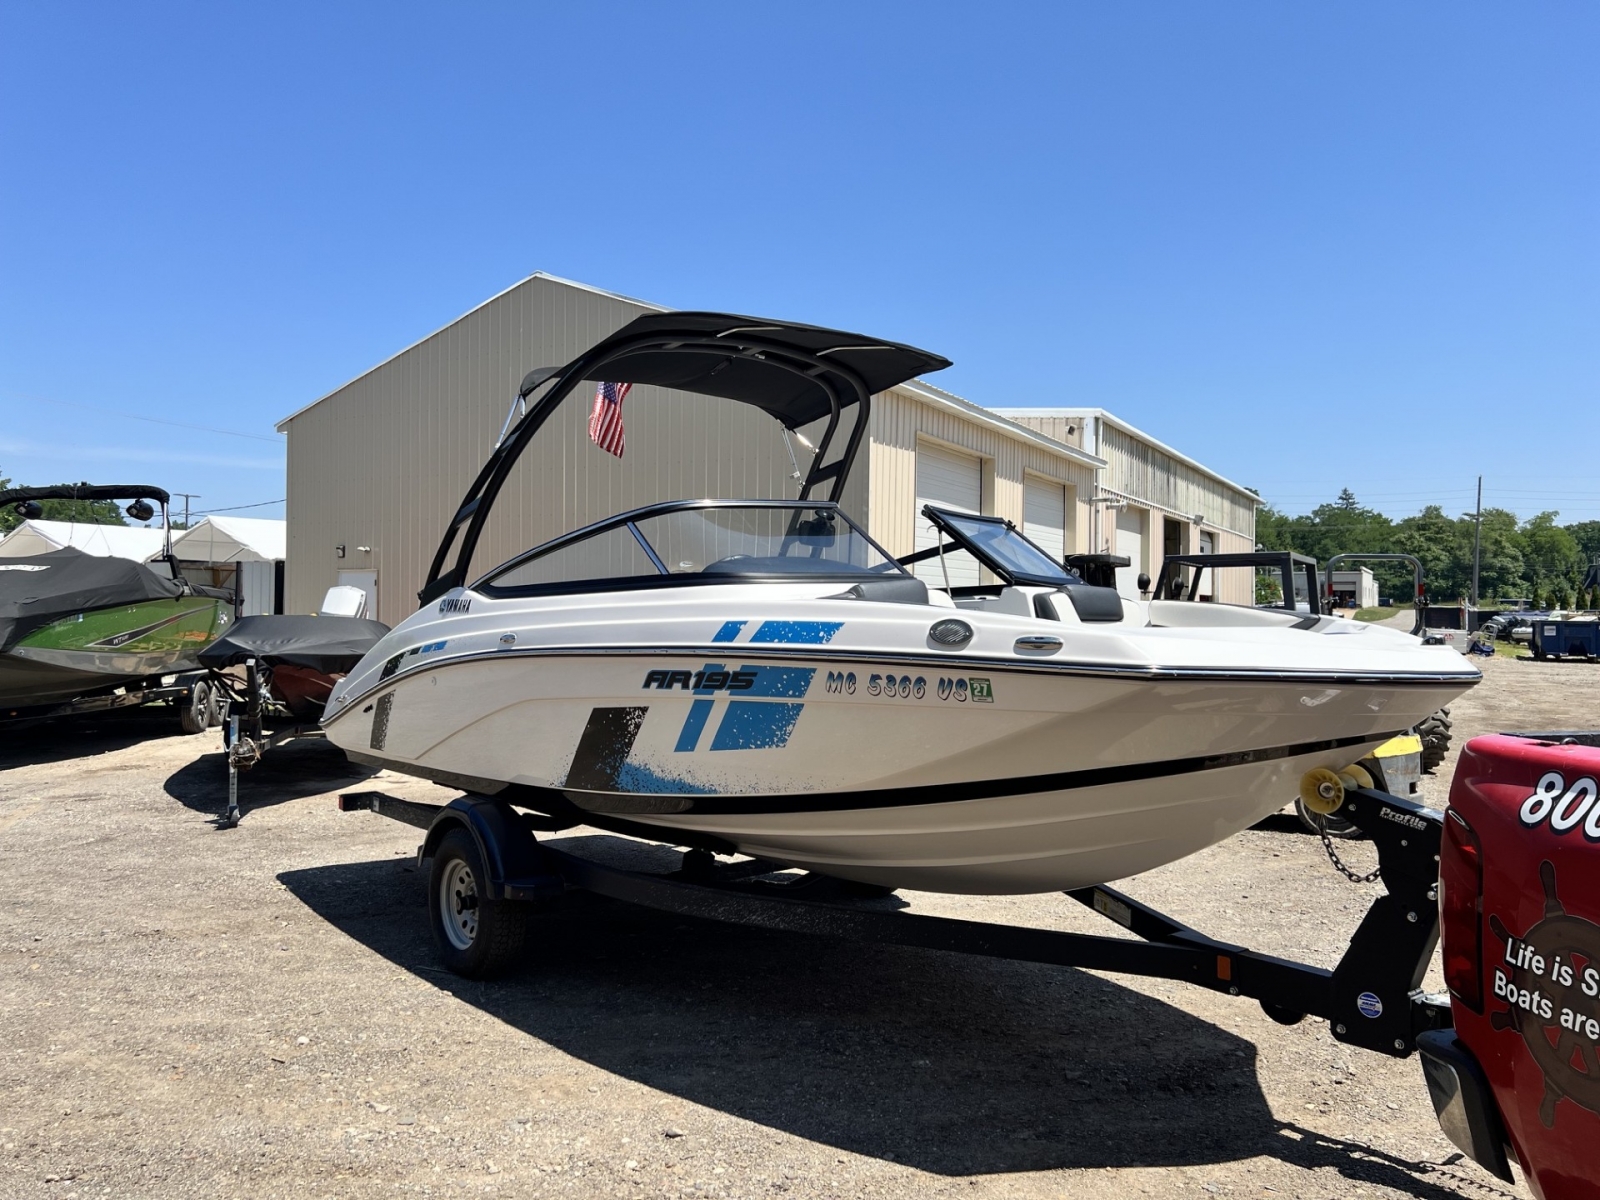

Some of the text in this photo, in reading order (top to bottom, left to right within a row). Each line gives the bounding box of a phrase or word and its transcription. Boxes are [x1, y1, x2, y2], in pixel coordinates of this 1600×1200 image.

[446, 599, 471, 614] YAMAHA
[641, 669, 758, 690] AR195
[825, 671, 857, 695] MC
[867, 673, 927, 700] 5366
[973, 683, 988, 696] 27
[1380, 806, 1427, 828] Profile
[1505, 937, 1600, 999] Life is S
[1494, 969, 1600, 1040] Boats are
